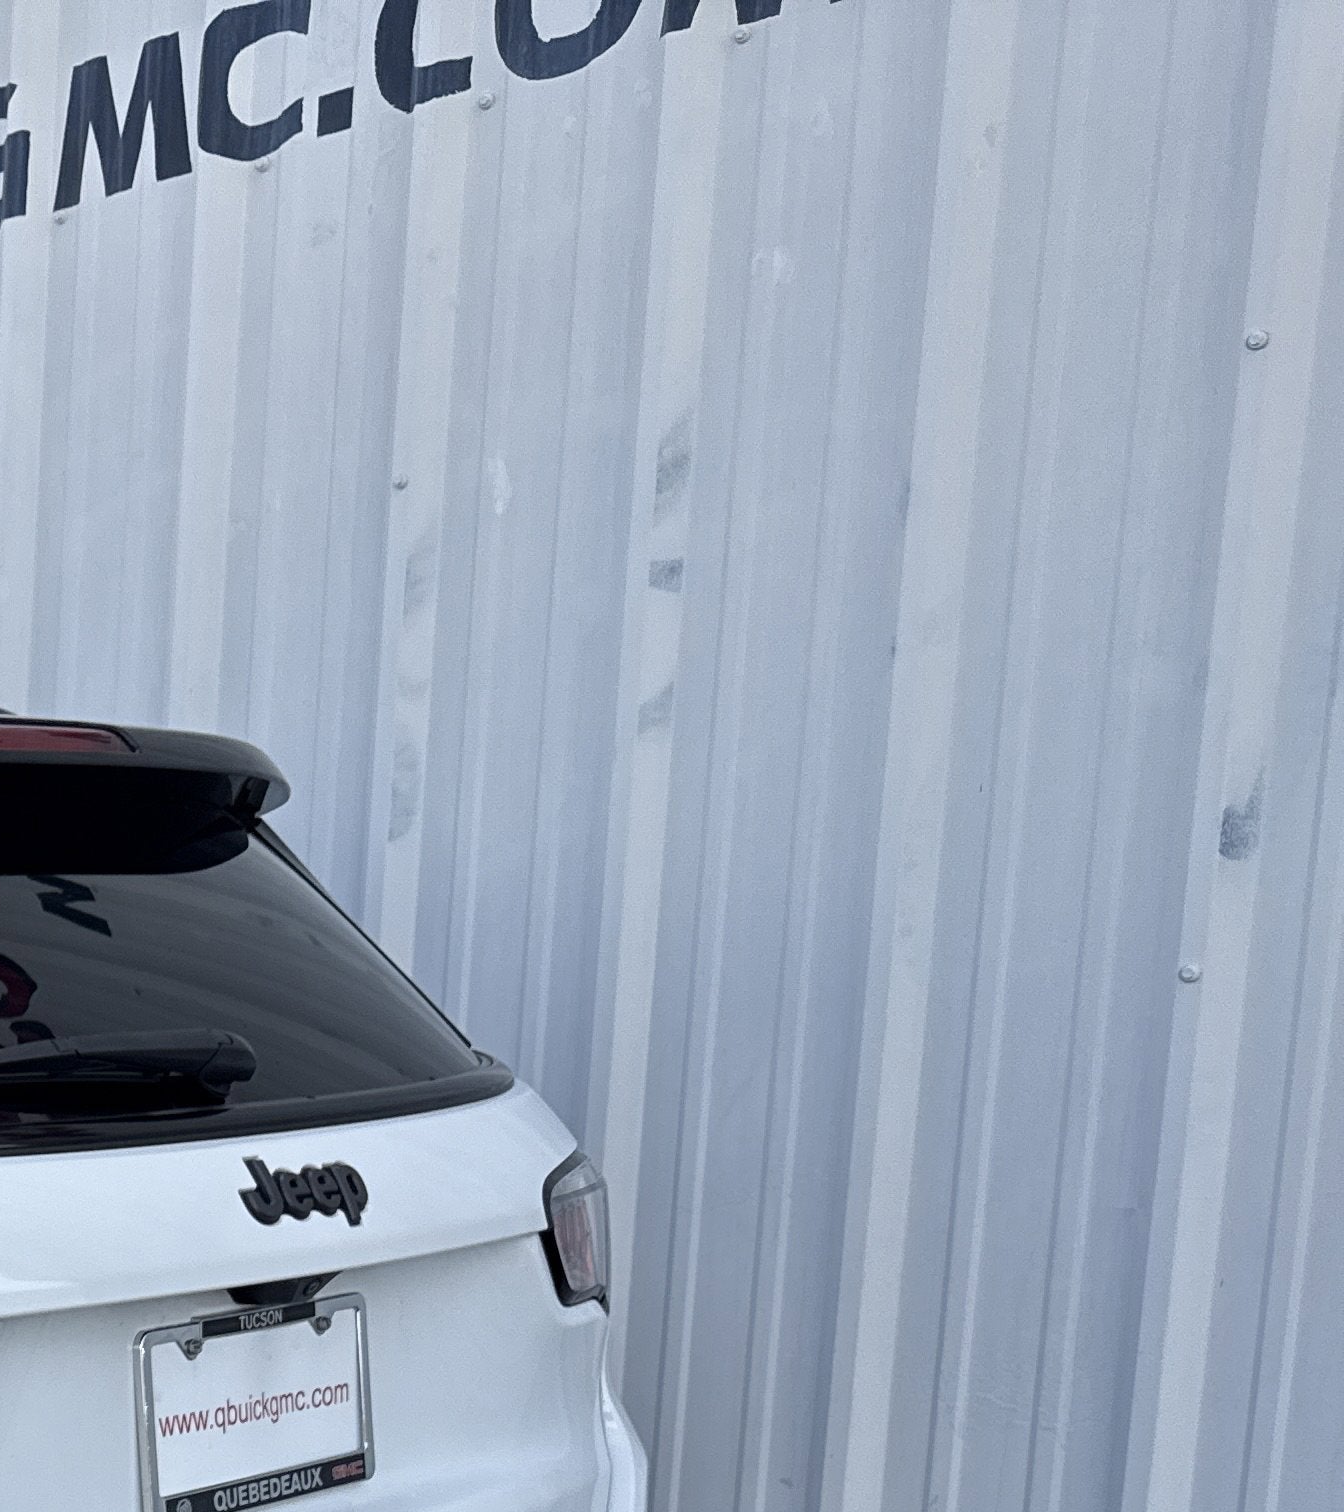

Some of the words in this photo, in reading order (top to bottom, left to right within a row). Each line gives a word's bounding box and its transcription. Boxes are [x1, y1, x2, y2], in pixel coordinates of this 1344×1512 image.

[238, 1156, 369, 1227] Jeep
[238, 1309, 283, 1331] TUCSON
[158, 1382, 349, 1438] www.qbuickgmc.com
[213, 1467, 324, 1512] QUEBEDEAUX
